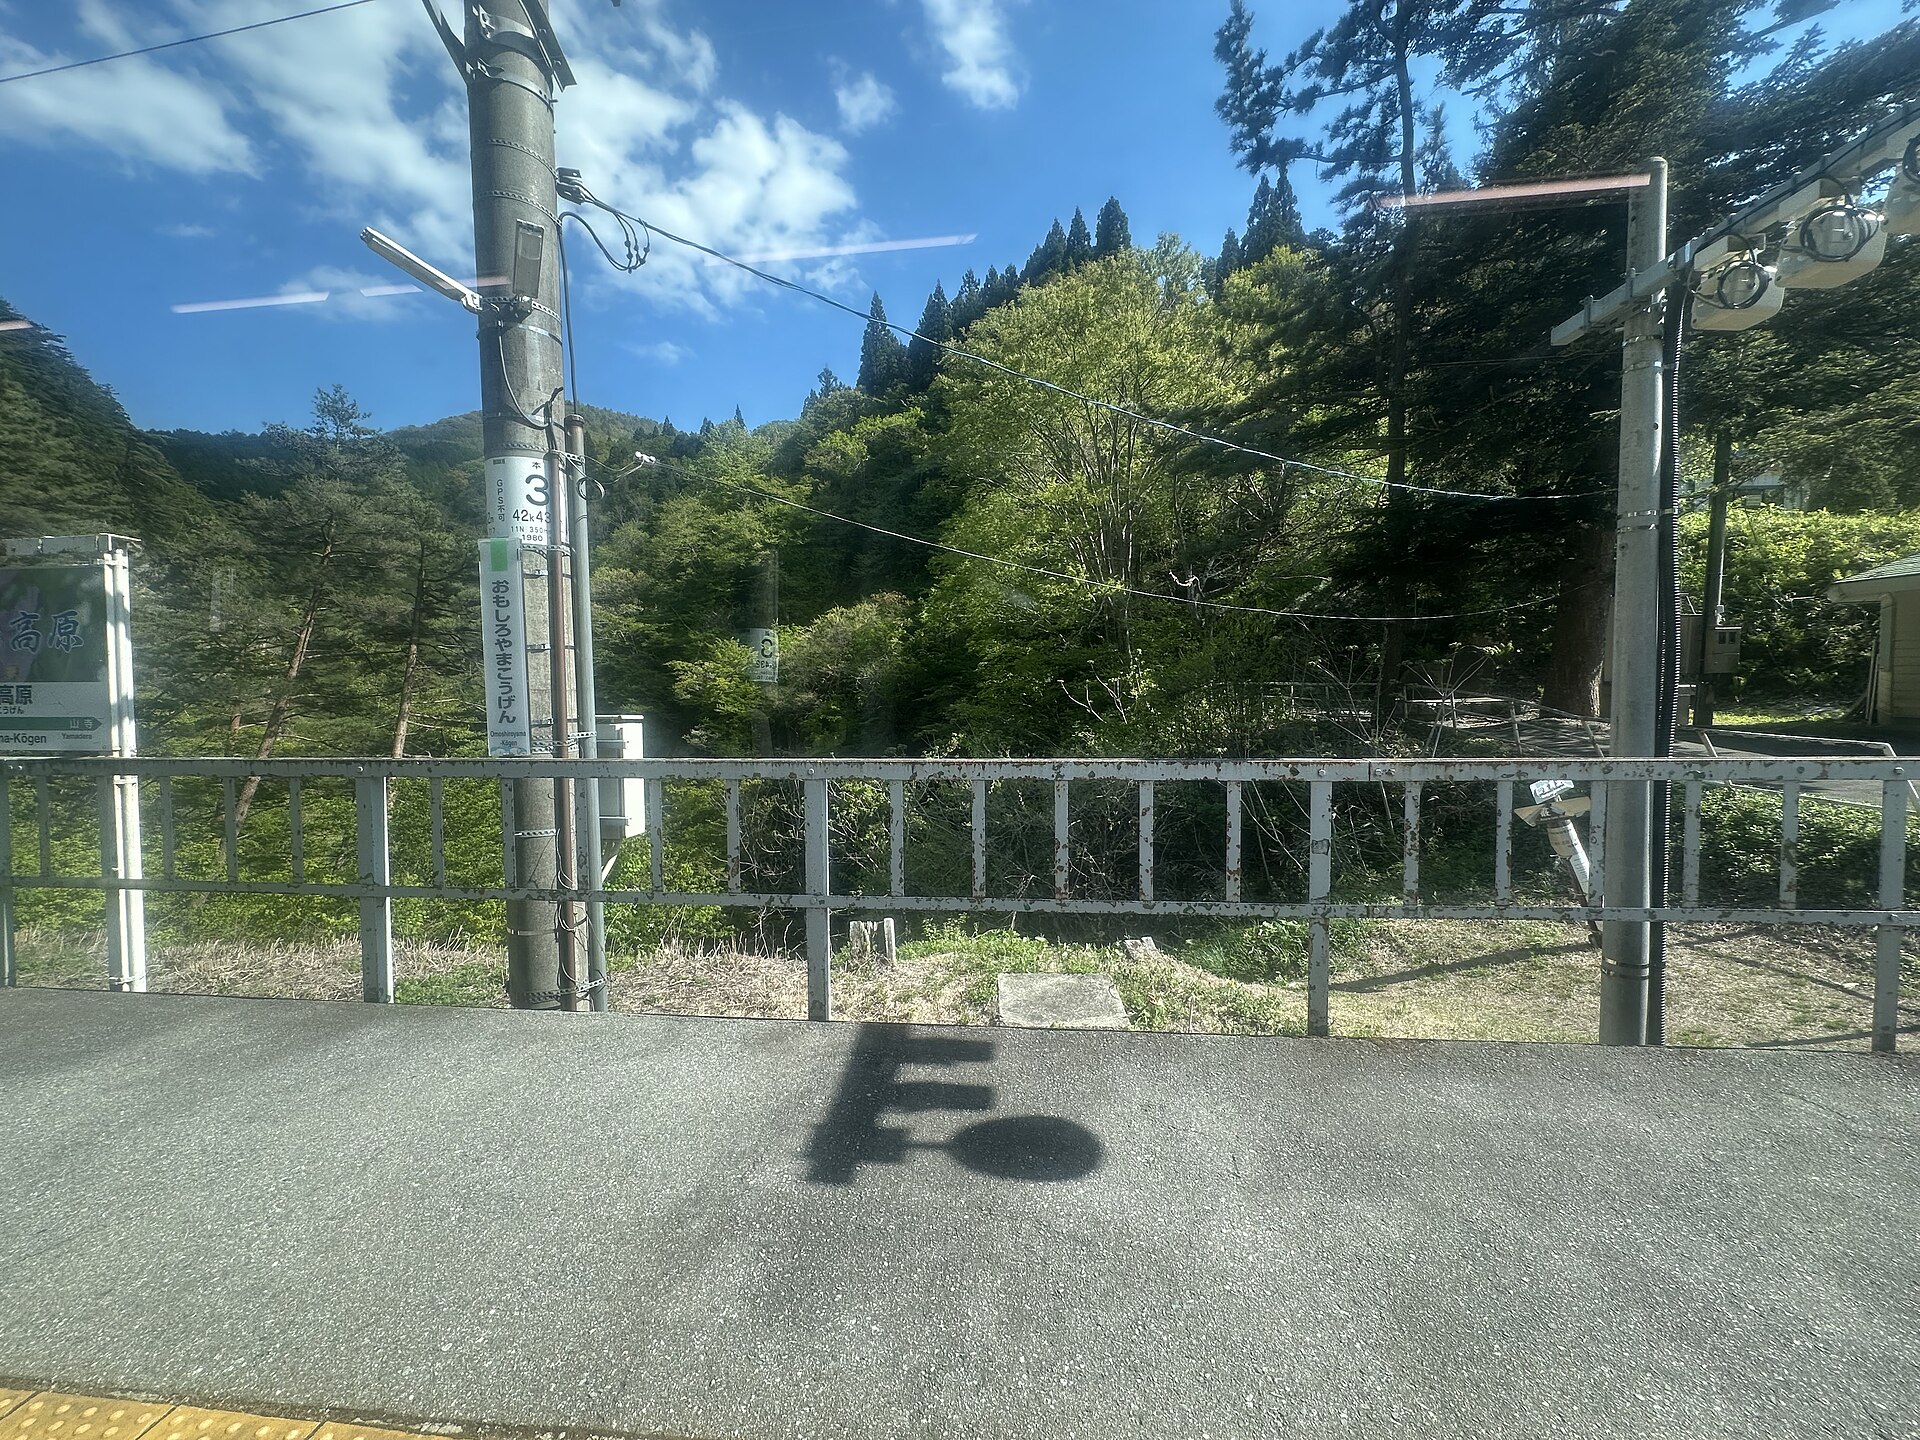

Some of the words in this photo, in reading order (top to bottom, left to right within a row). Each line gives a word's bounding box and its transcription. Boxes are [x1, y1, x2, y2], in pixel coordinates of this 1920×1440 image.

[525, 474, 550, 506] 3
[522, 534, 543, 542] 1980
[10, 610, 84, 655] 高原
[491, 579, 517, 724] おもしろやまこうげん
[0, 685, 33, 705] 高原
